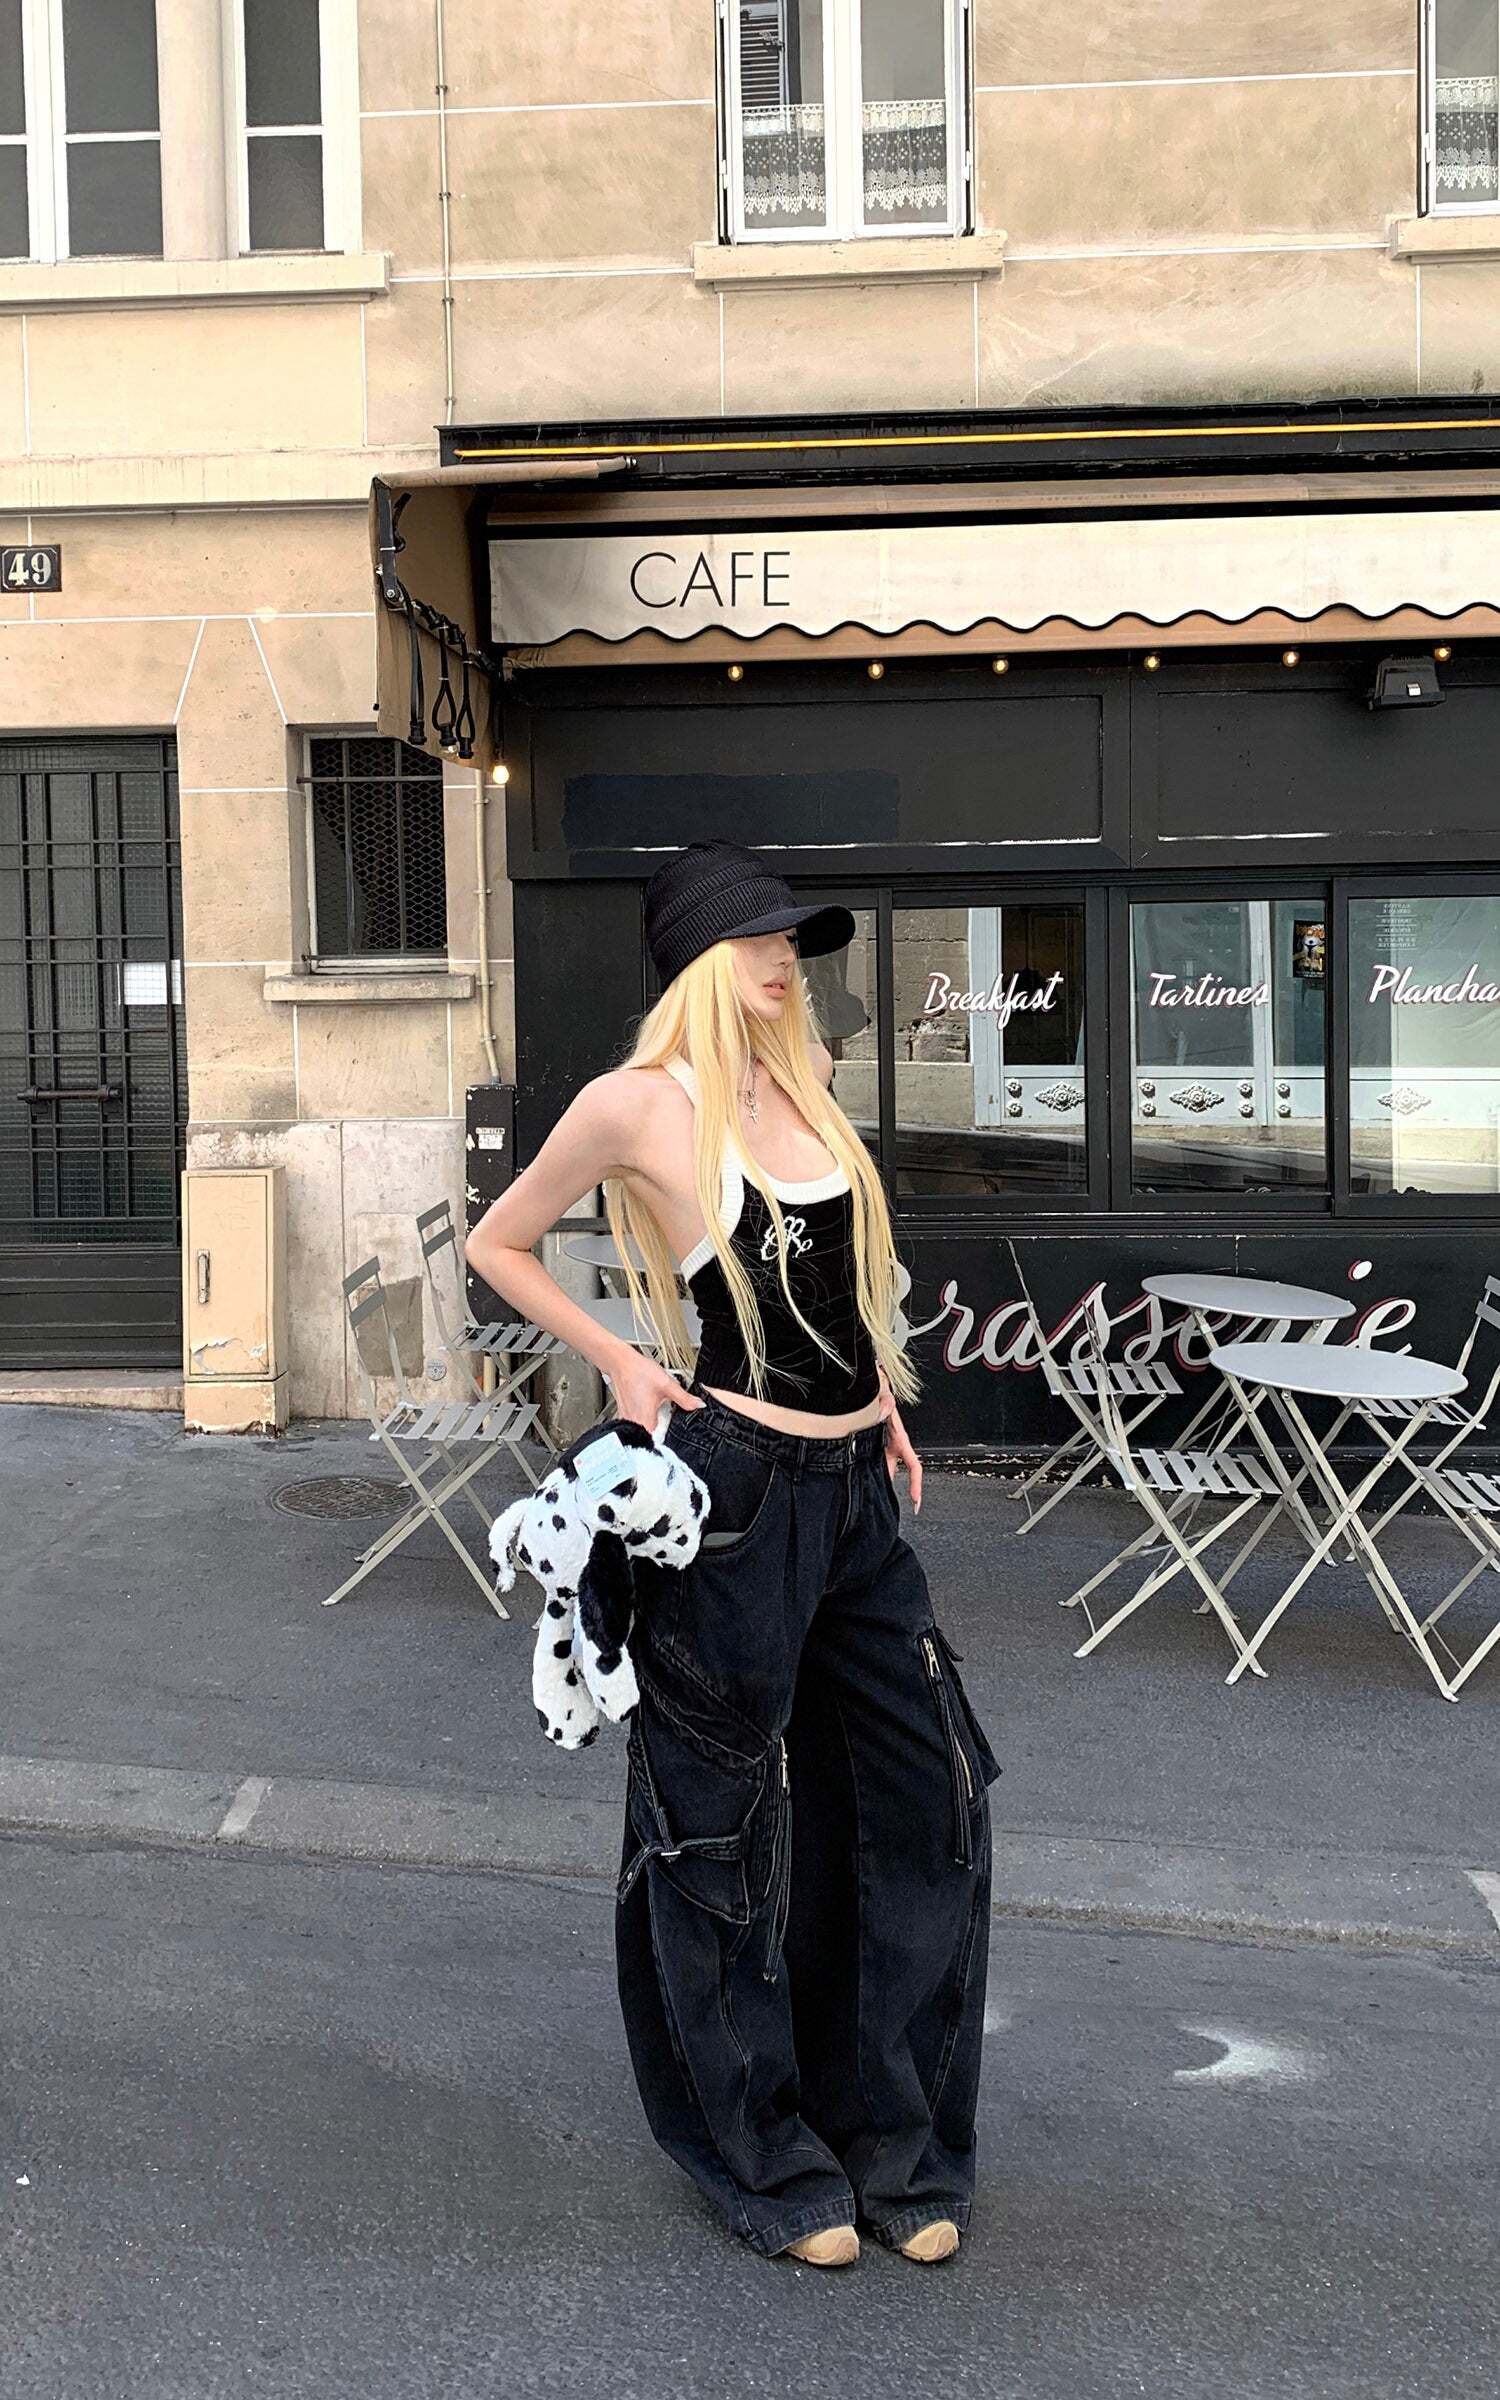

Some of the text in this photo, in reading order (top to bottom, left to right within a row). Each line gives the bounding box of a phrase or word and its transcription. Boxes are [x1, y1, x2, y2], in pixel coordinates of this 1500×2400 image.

[8, 552, 51, 586] 49
[630, 551, 790, 608] CAFE
[922, 971, 1065, 1031] Breakfast
[1148, 972, 1270, 1007] Tartines
[1367, 964, 1500, 1004] Plancha
